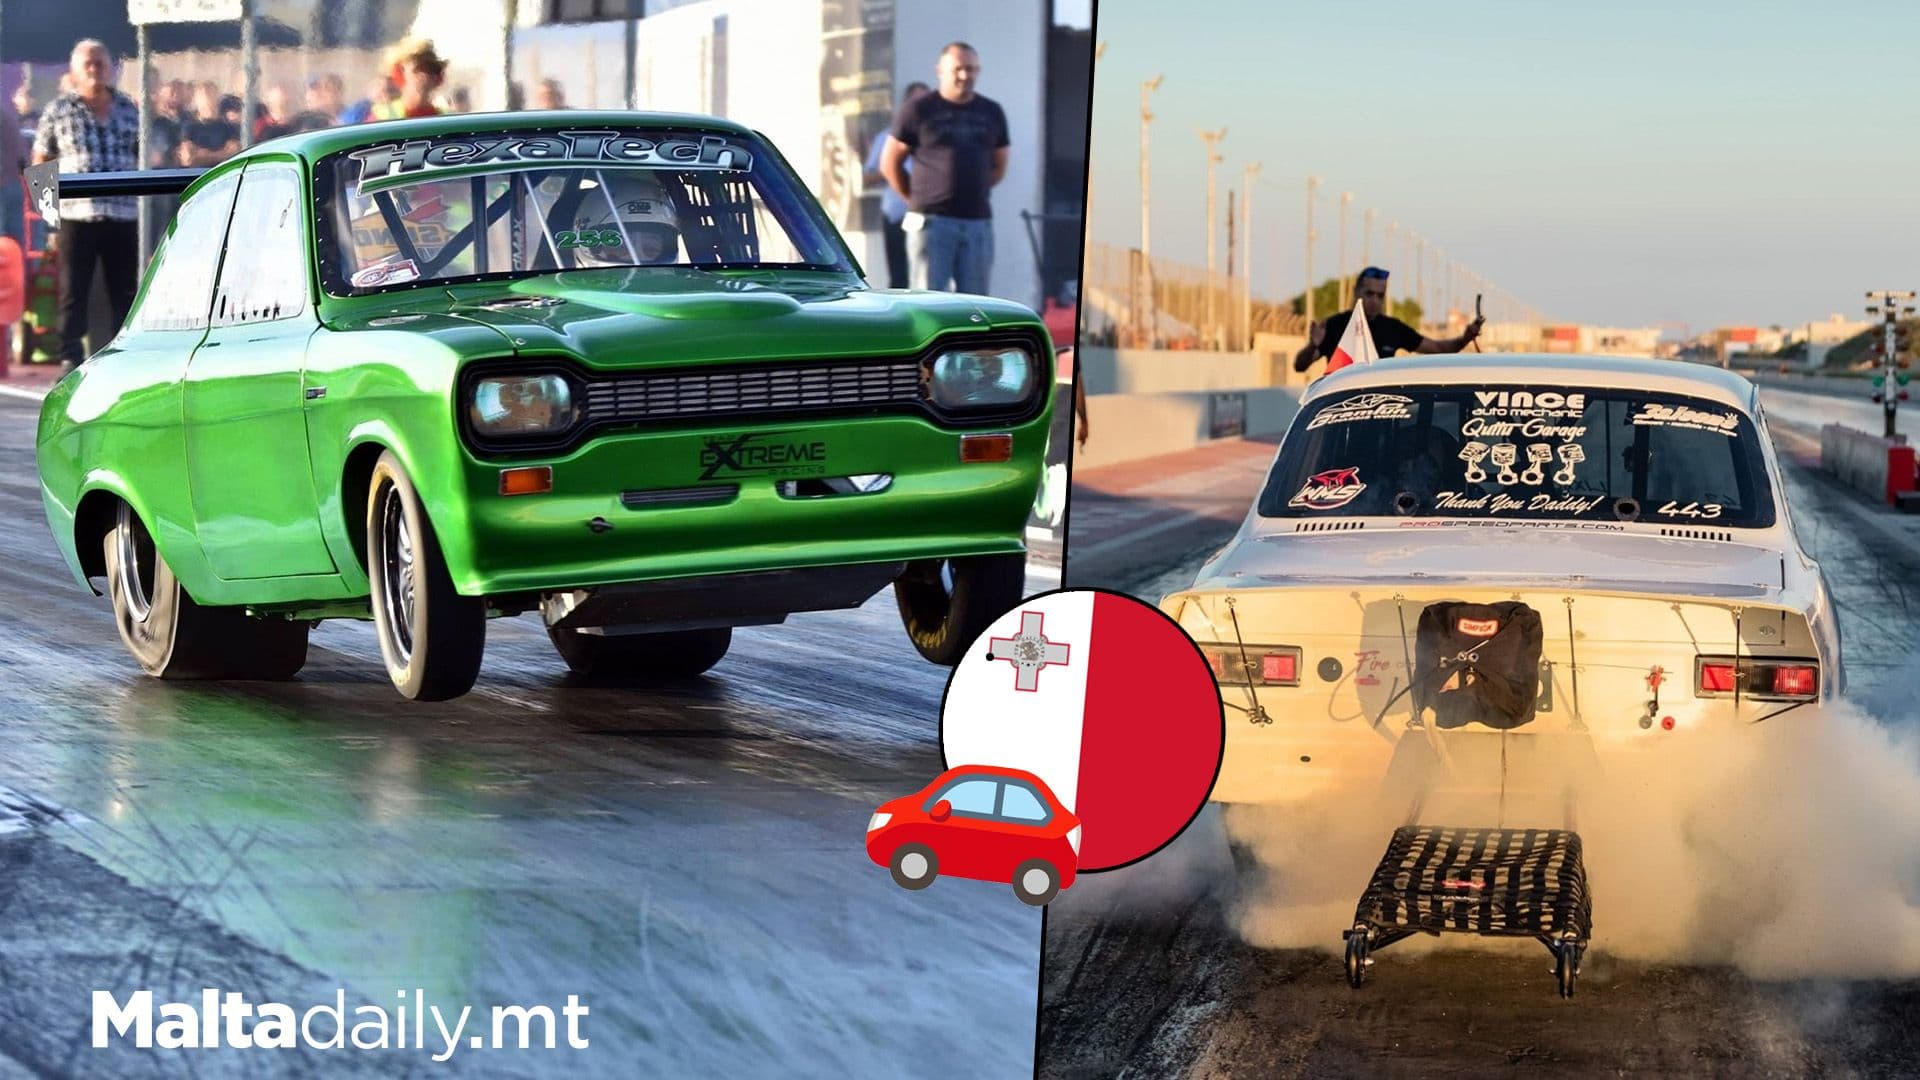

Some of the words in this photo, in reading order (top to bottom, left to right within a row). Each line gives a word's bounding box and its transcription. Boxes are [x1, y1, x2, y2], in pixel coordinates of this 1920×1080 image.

[348, 130, 754, 184] HexaTech
[555, 229, 623, 250] 256
[1474, 391, 1586, 409] VINCE
[1472, 407, 1507, 417] auto
[1510, 407, 1584, 418] mechanic
[1521, 418, 1587, 443] Garage
[1435, 491, 1491, 510] Thank
[1489, 493, 1525, 514] You
[1527, 493, 1605, 515] Daddy!
[1657, 501, 1722, 518] 443
[1400, 520, 1625, 532] PROSPEEDPARTS.COM
[1354, 650, 1391, 673] Fire
